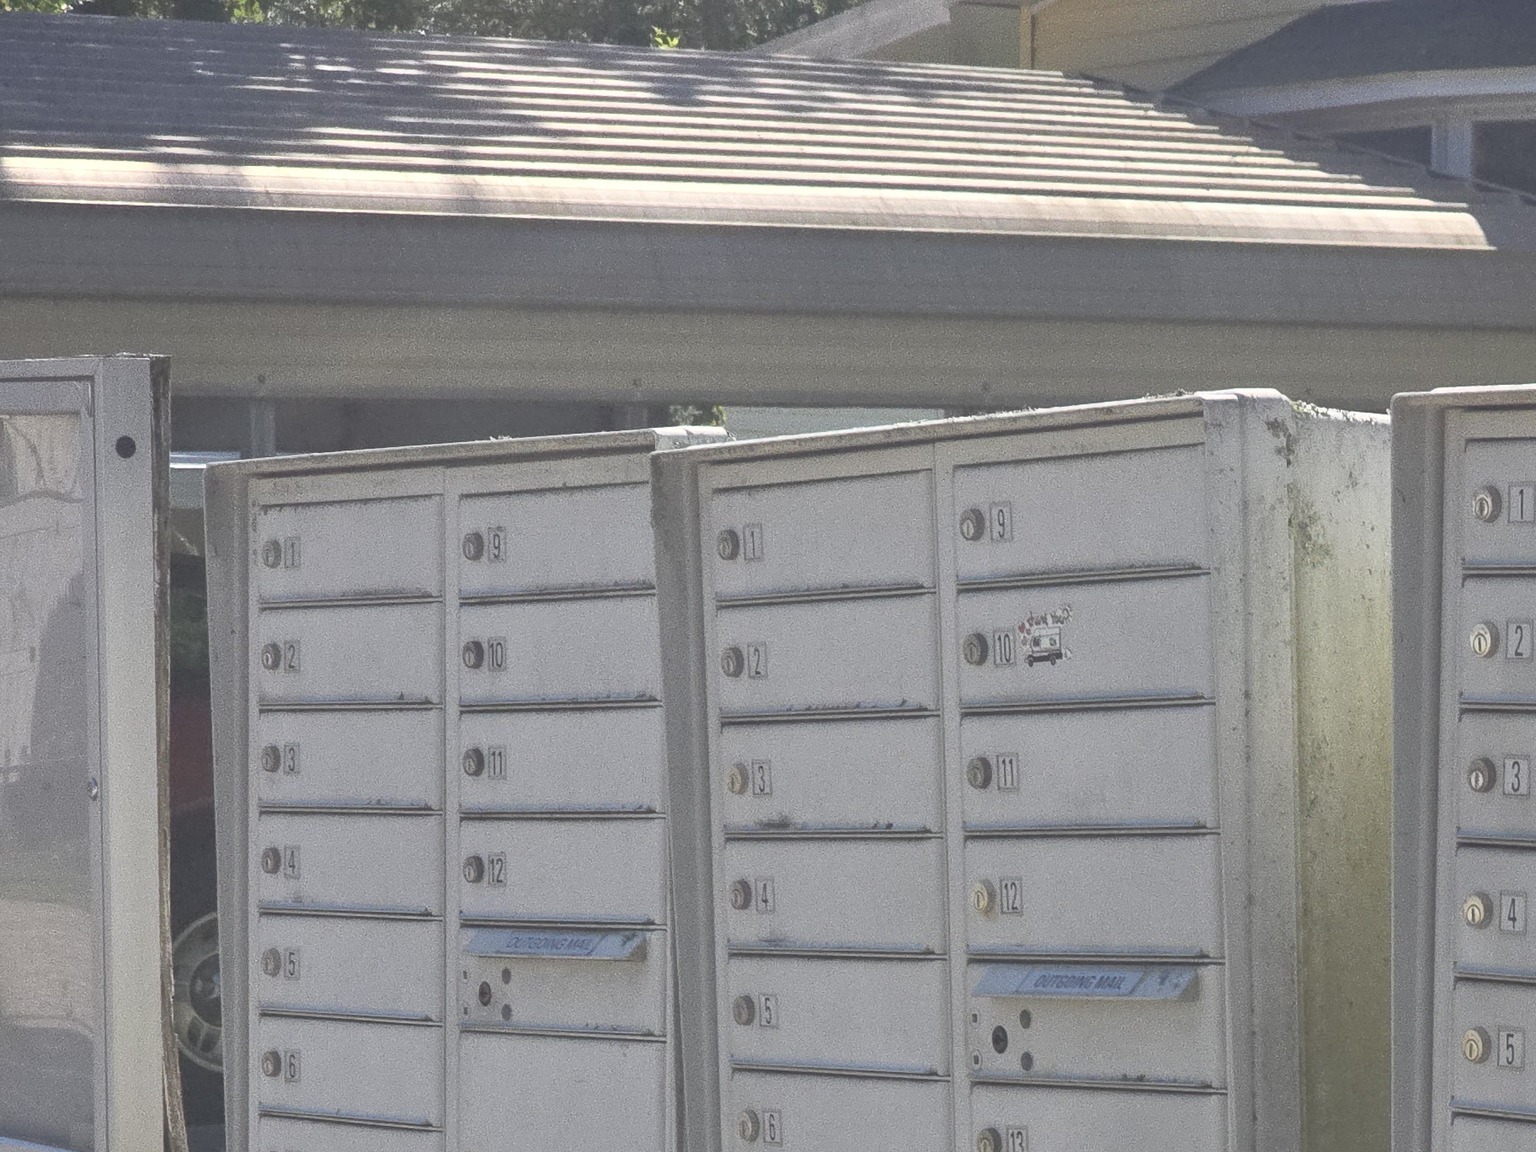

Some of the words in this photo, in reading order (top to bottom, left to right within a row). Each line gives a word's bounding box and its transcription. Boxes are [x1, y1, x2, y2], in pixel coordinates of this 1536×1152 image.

[998, 509, 1005, 538] 9
[998, 633, 1012, 662] 10
[1514, 625, 1523, 656] 2
[1001, 758, 1014, 786] 11
[1511, 761, 1520, 792] 3
[1004, 882, 1018, 911] 12
[1507, 898, 1517, 928] 4
[1034, 974, 1096, 989] OUTGOING
[1506, 1033, 1514, 1065] 5
